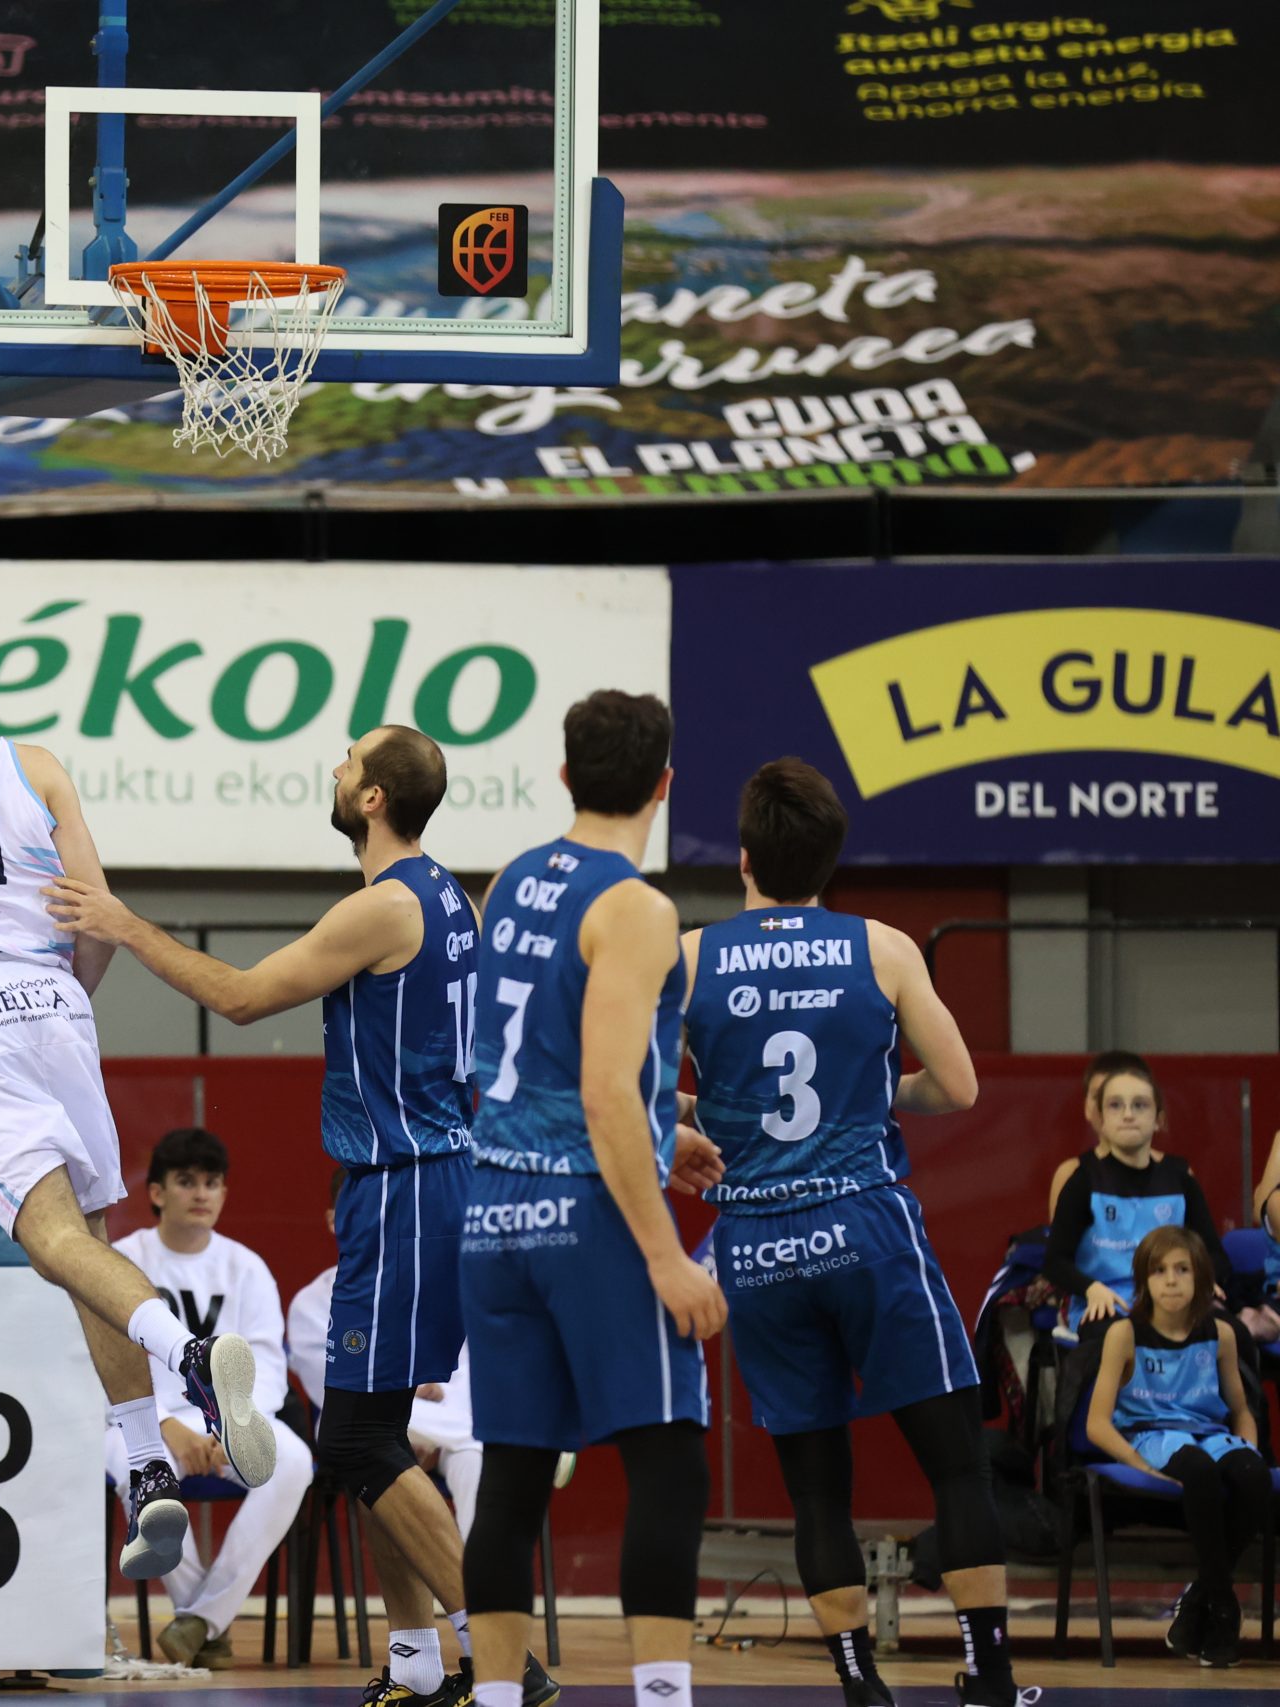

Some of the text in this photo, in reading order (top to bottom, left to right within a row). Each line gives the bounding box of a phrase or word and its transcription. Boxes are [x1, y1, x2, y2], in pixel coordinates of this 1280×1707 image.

[489, 212, 510, 222] FEB
[722, 378, 969, 440] CUIDA
[535, 414, 989, 478] EL PLANETA
[887, 649, 1280, 742] LA GULA
[975, 782, 1219, 817] DEL NORTE
[716, 939, 852, 975] JAWORSKI
[484, 977, 534, 1102] 7
[761, 1031, 821, 1142] 3
